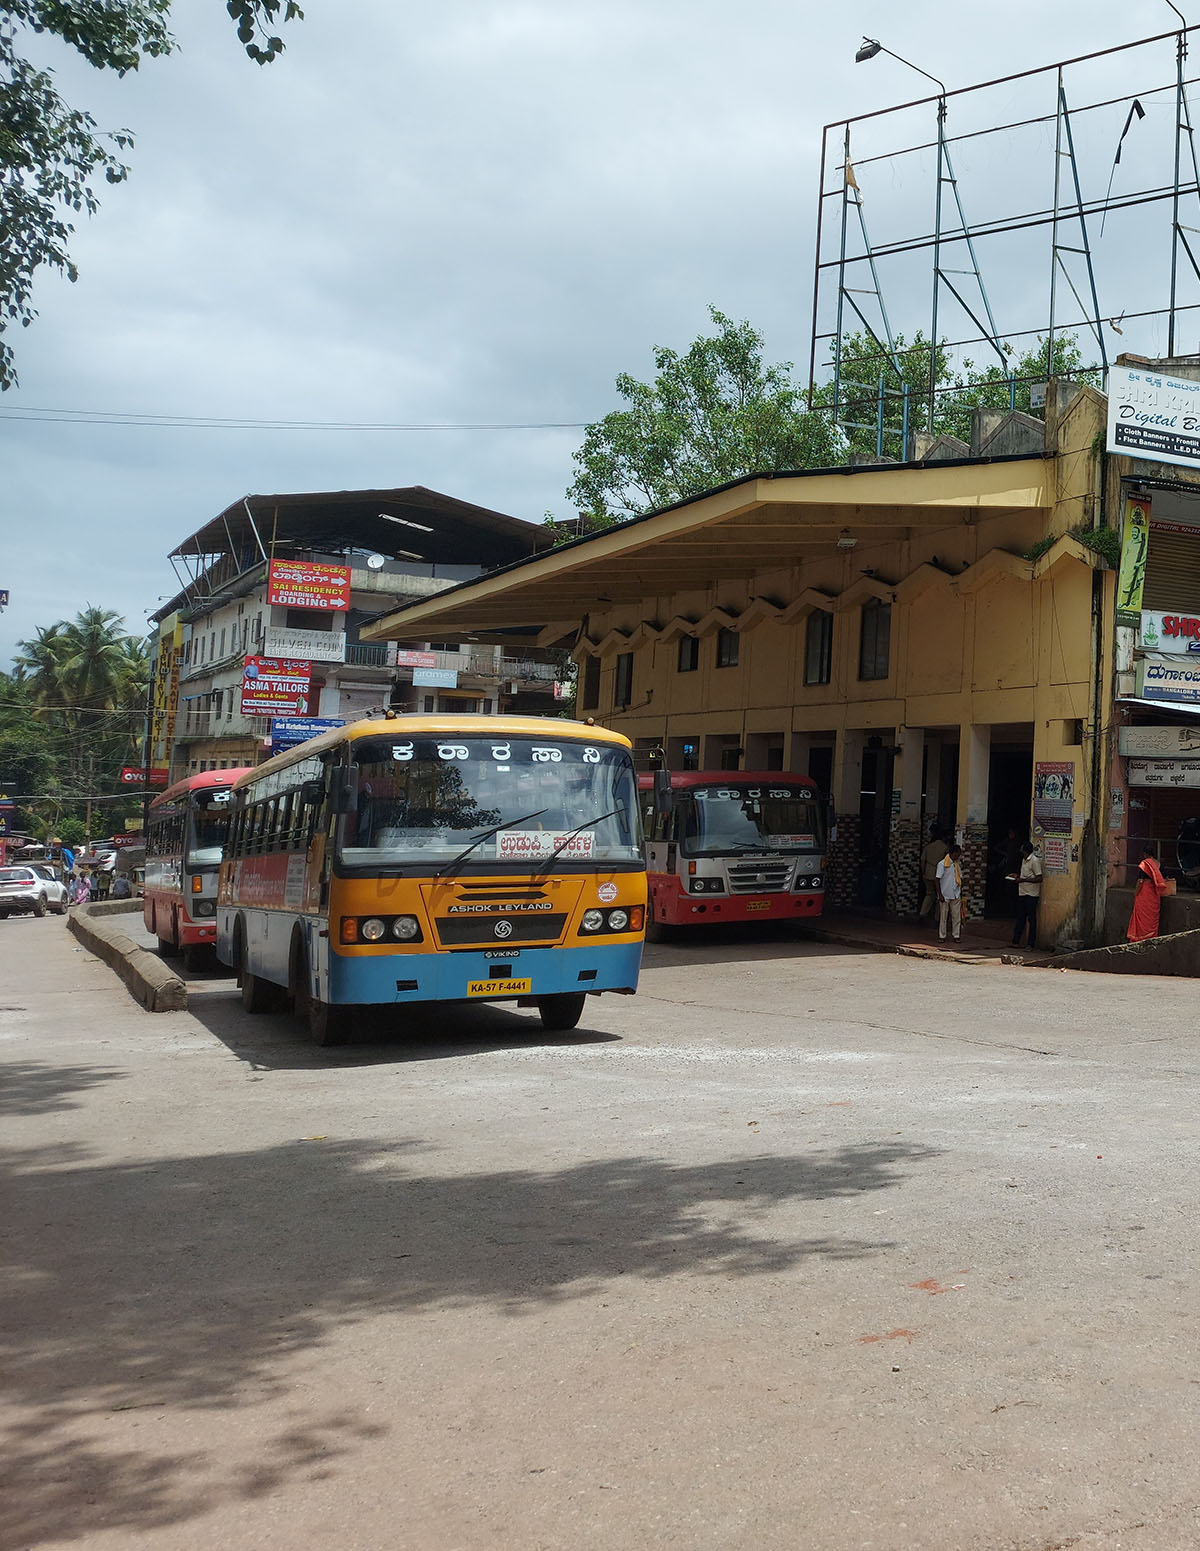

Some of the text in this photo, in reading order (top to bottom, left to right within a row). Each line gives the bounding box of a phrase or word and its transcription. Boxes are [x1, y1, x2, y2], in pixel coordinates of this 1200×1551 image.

[1119, 404, 1178, 428] Digital
[1124, 427, 1141, 436] Cloth
[1143, 431, 1170, 442] Banners
[1123, 435, 1138, 444] Flex
[1139, 438, 1166, 449] Banners
[279, 590, 315, 598] BOARDING
[291, 584, 344, 595] RESIDENCY
[271, 594, 328, 608] LODGING
[415, 670, 456, 679] aramex
[244, 680, 309, 694] ASMA TAILORS
[392, 740, 601, 763] ಕ ರಾ ರ ಸಾ ನಿ
[500, 832, 542, 851] ಉಡುಪಿ
[449, 902, 553, 913] ASHOK LEYLAND
[471, 981, 526, 993] KA-57 F-4441
